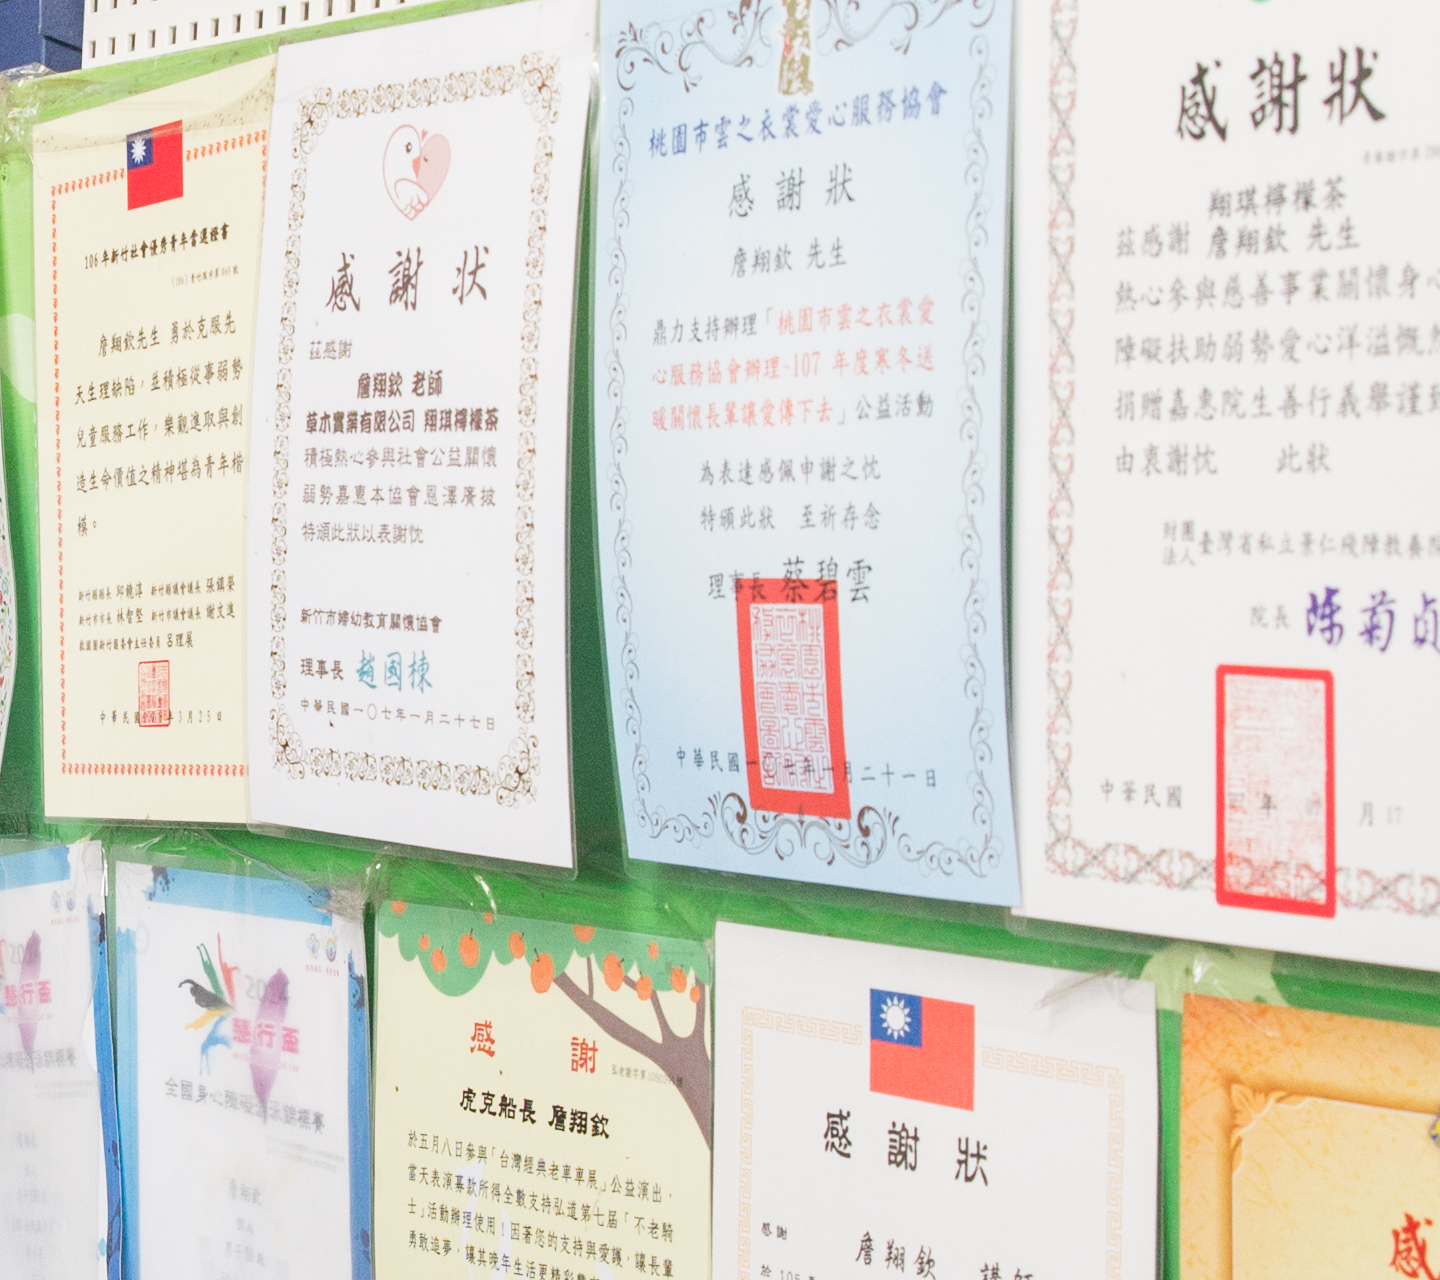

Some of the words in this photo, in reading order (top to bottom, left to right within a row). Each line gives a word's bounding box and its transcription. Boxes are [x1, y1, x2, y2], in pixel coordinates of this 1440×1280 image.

[1175, 45, 1387, 143] 感謝狀
[648, 80, 949, 159] 桃園市雲之衣裳愛心服務協會
[728, 163, 856, 218] 感謝狀
[1208, 176, 1348, 220] 翔琪檸檬茶
[730, 244, 793, 280] 詹翔欽
[806, 236, 848, 270] 先生
[1115, 222, 1190, 258] 茲感謝
[1205, 225, 1290, 260] 詹翔欽
[1306, 217, 1361, 253] 先生
[325, 245, 489, 313] 感謝狀
[97, 326, 161, 358] 詹翔欽先生
[169, 309, 237, 346] 勇於克服先
[357, 372, 403, 400] 詹翔欽
[410, 369, 443, 397] 老師
[304, 409, 415, 436] 草木實業有限公司
[423, 407, 500, 433] 翔琪檸檬茶
[303, 445, 497, 470] 積極熱心參與社會公益關懷
[1114, 441, 1220, 478] 由衷謝忱
[1277, 443, 1332, 476] 此狀
[301, 521, 424, 545] 特頒此狀以表謝忱
[700, 505, 777, 532] 特頒此狀
[799, 501, 881, 533] 至祈存念
[300, 608, 443, 634] 新竹市婦幼教育關懷協會
[1249, 604, 1290, 631] 院長
[300, 657, 344, 681] 理事長
[1100, 778, 1183, 810] 中華民國
[459, 1087, 537, 1125] 虎克船長
[548, 1103, 610, 1139] 詹翔欽
[822, 1107, 990, 1188] 感謝狀
